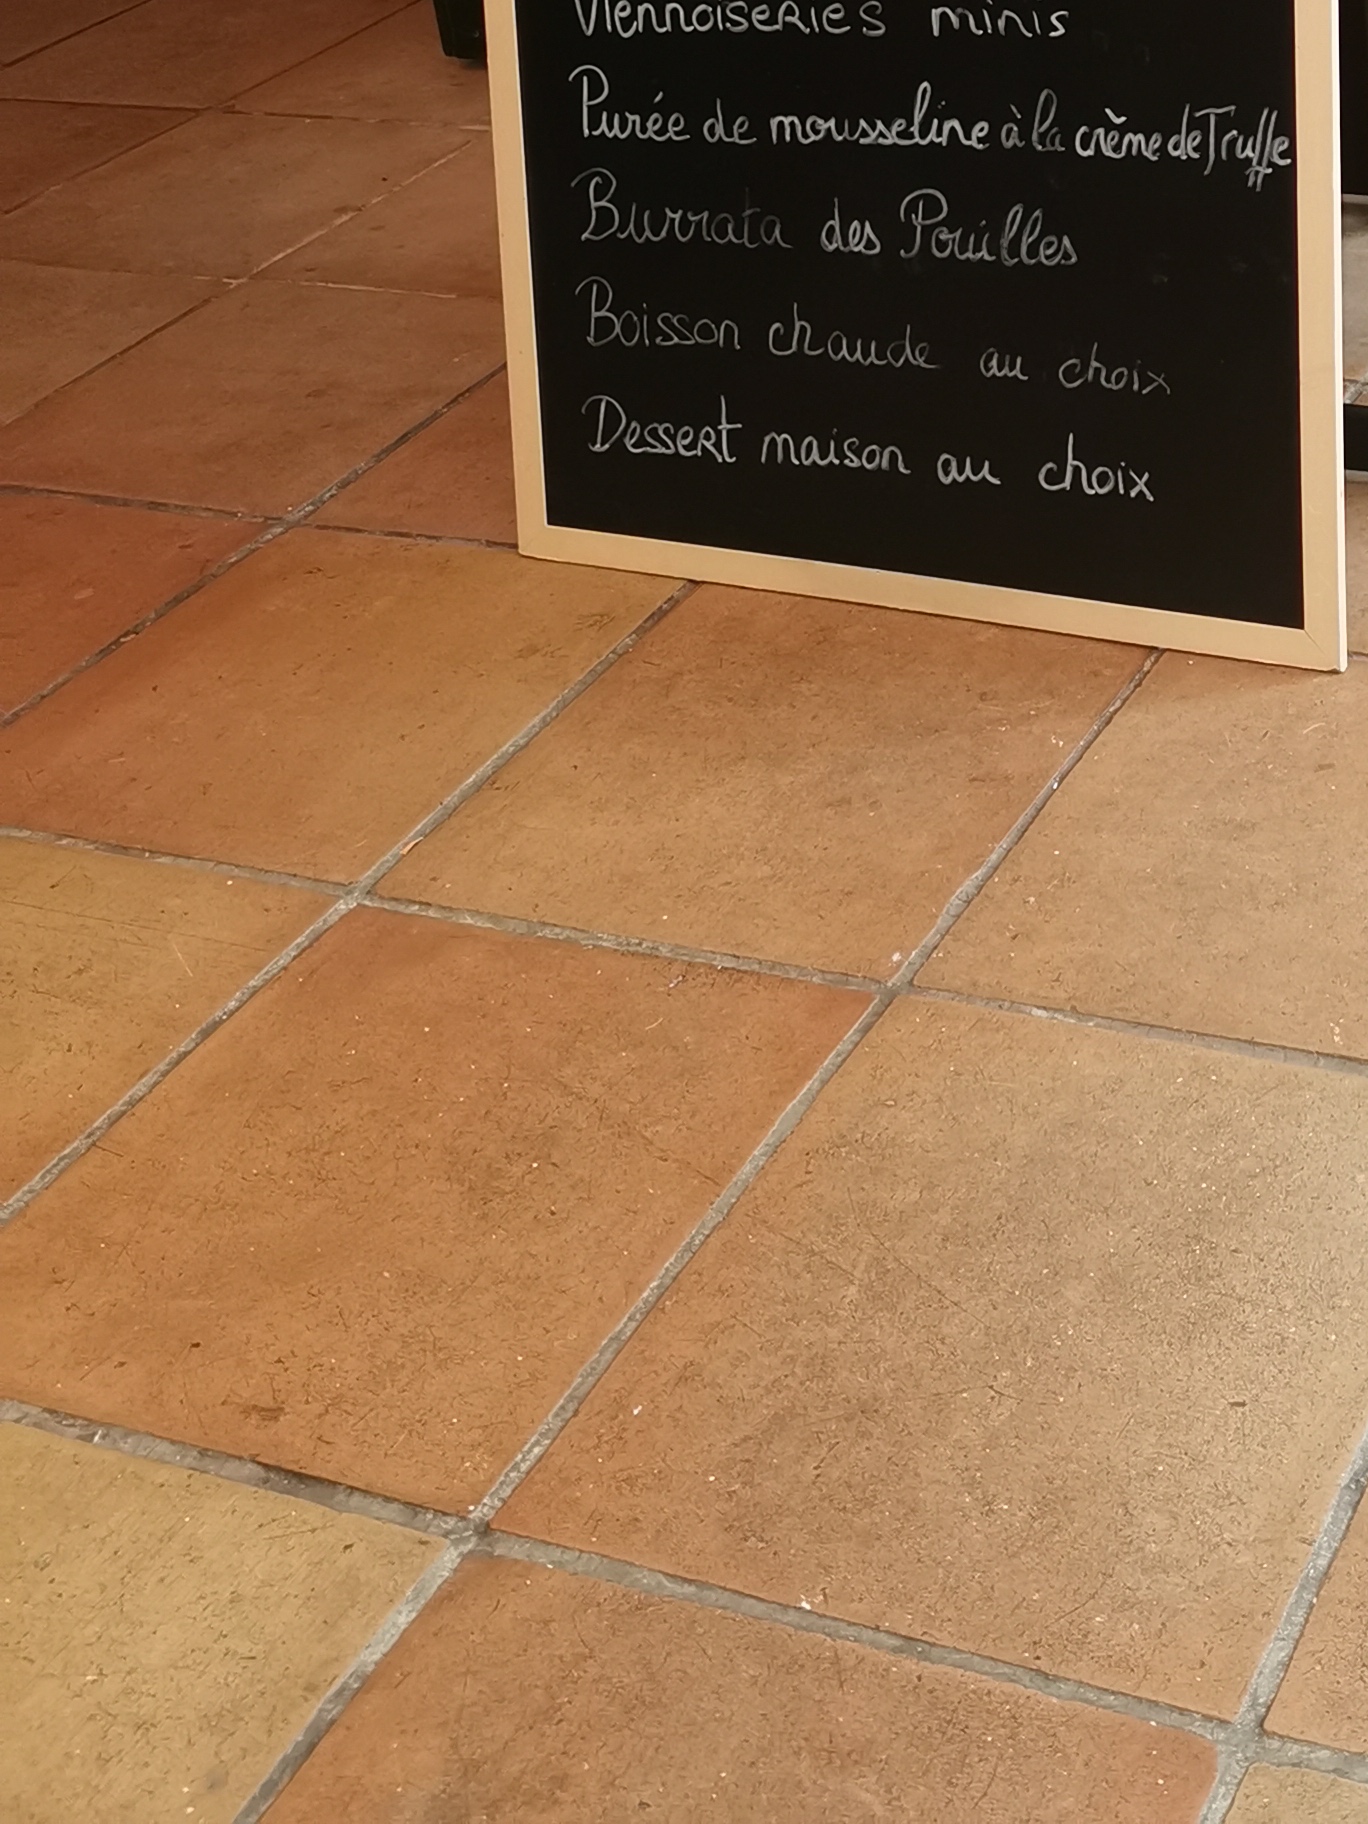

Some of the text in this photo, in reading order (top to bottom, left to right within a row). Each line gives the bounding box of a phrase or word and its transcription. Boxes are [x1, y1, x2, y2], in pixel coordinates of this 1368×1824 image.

[569, 65, 690, 141] Purée
[703, 99, 756, 144] de
[770, 81, 989, 149] mousseline
[1001, 105, 1025, 148] à
[1032, 89, 1065, 151] la
[1167, 104, 1201, 160] de
[1194, 105, 1292, 191] Truffe
[571, 168, 1077, 266] Burrata des Pouilles
[575, 277, 1170, 394] Boisson chaude au choix
[761, 432, 911, 474] maison
[937, 453, 1001, 484] au
[1038, 433, 1154, 501] choix
